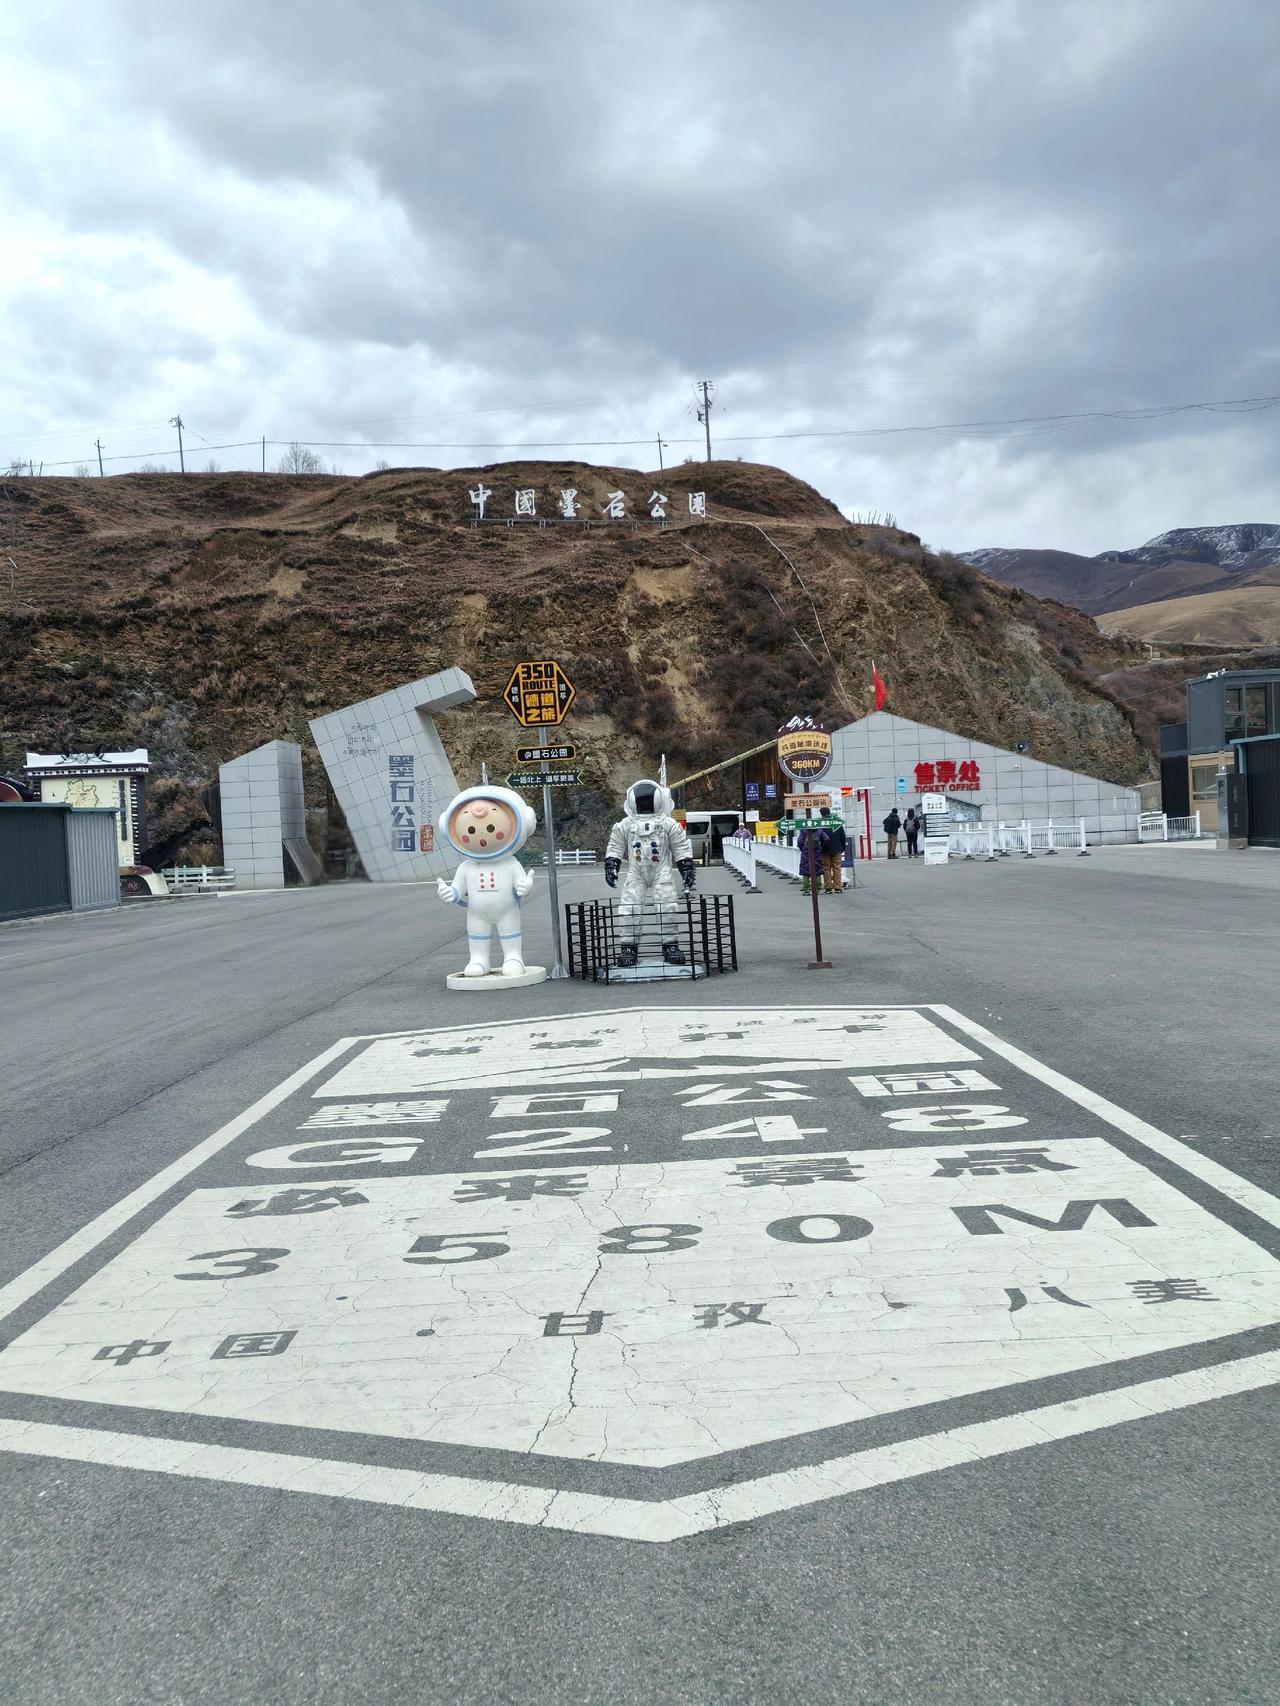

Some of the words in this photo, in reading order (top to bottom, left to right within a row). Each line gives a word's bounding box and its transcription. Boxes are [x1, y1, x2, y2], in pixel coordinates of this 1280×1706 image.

[521, 664, 554, 680] 350
[522, 680, 556, 690] ROUTE
[791, 759, 820, 769] 360KM
[914, 760, 980, 785] 售票处
[914, 785, 946, 793] TICKET
[949, 783, 980, 791] OFFICE
[245, 1104, 1029, 1169] G248
[173, 1197, 1158, 1281] 3580M
